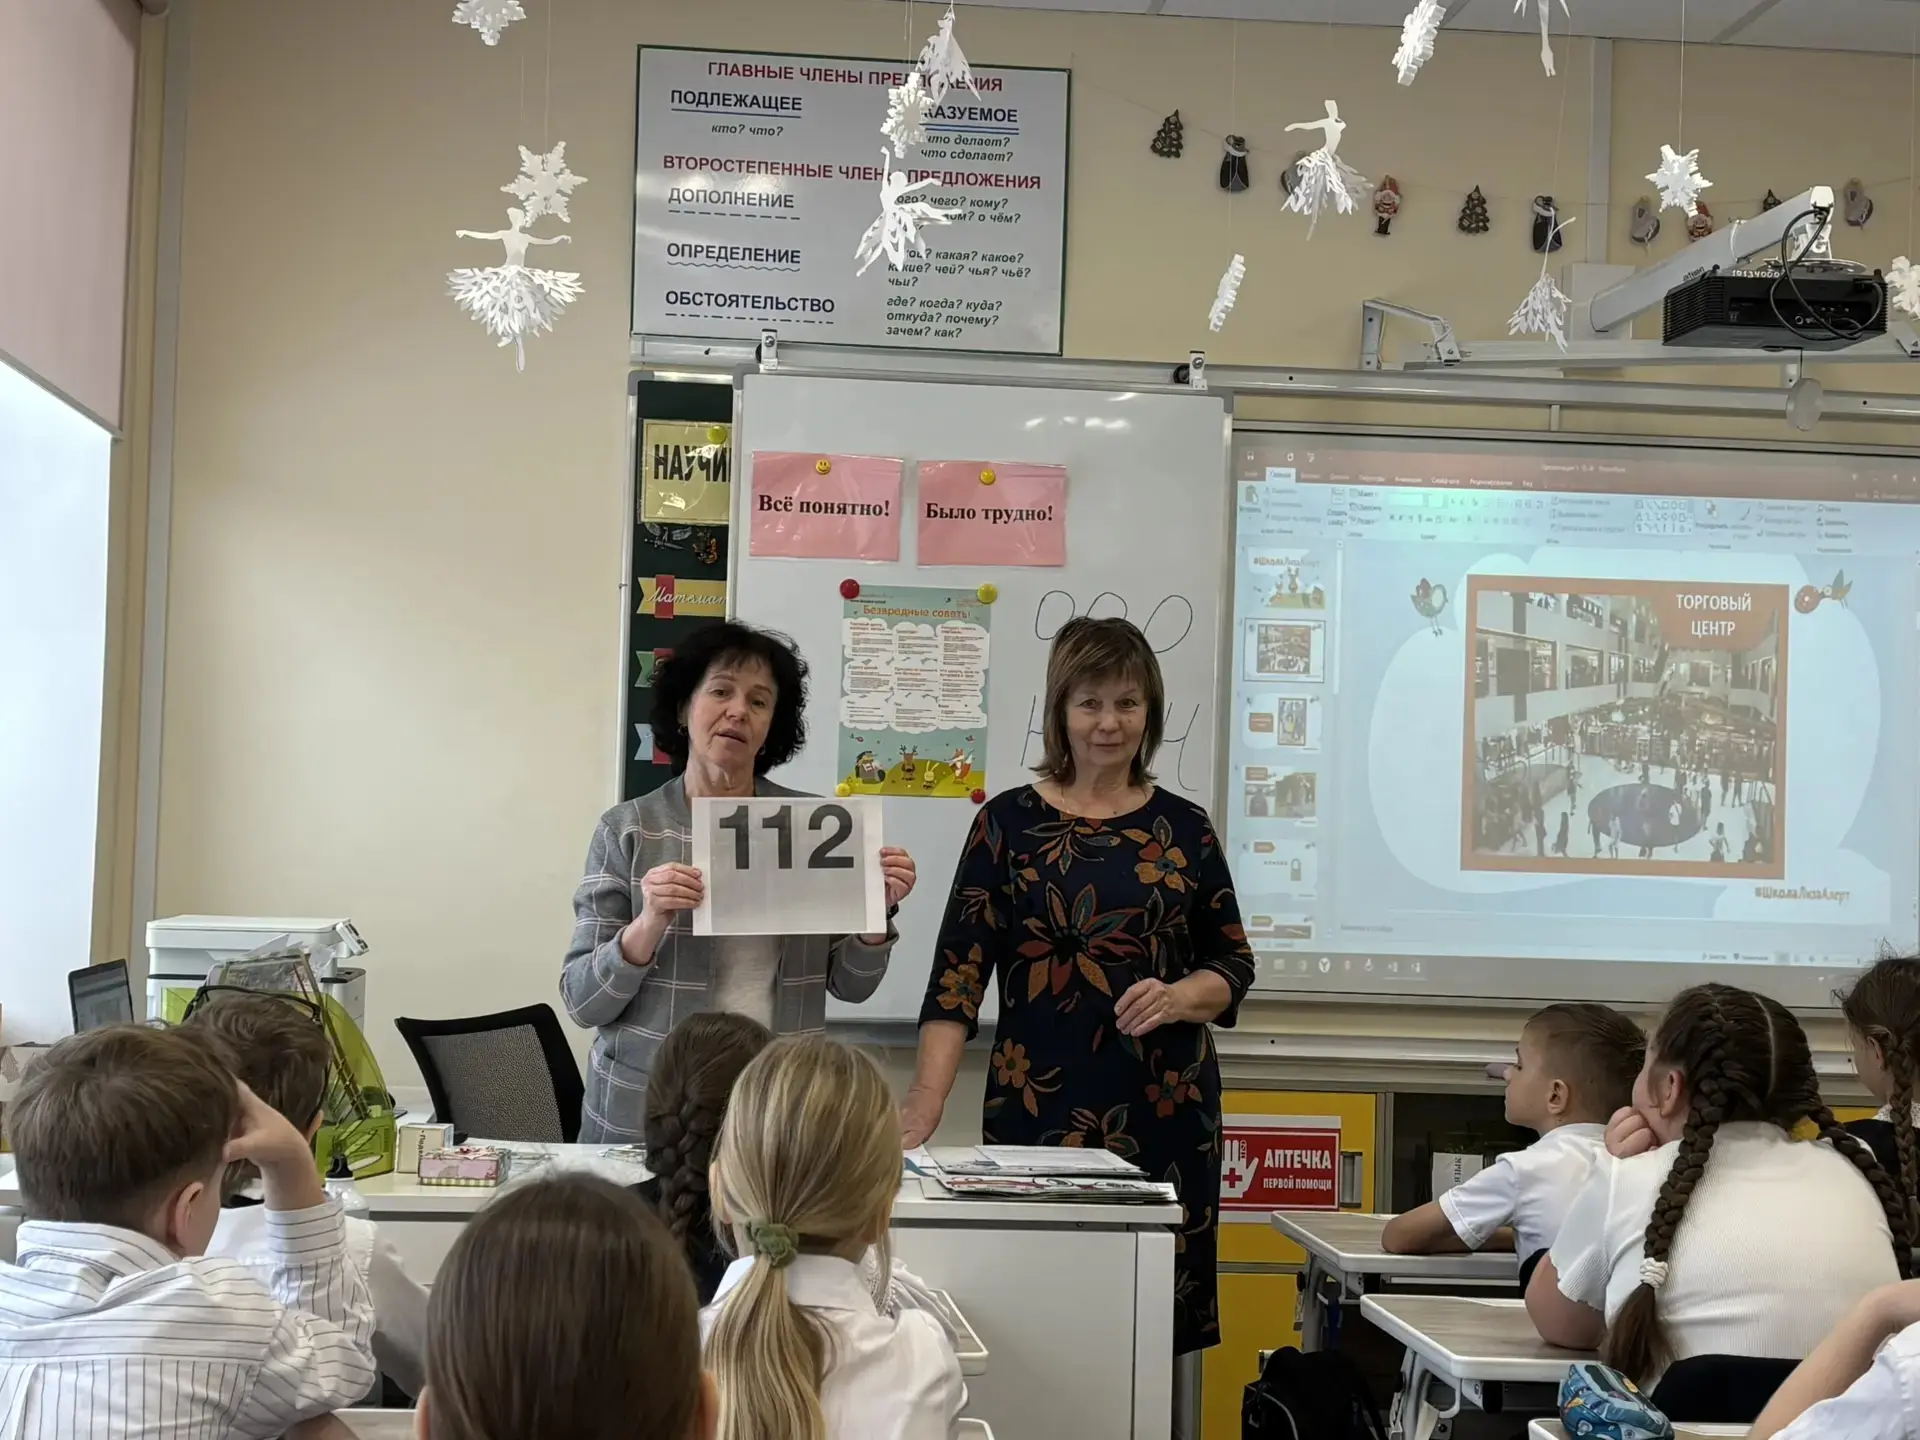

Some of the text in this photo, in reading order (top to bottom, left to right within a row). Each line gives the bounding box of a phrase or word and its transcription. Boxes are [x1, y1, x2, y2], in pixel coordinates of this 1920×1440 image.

[708, 62, 794, 80] ГЛАВНЫЕ
[800, 67, 863, 84] ЧЛЕНЫ
[671, 90, 802, 112] ПОДЛЕЖАЩЕЕ
[712, 124, 784, 136] кто? что?
[954, 134, 1010, 147] делает?
[921, 149, 1013, 161] что сделает?
[663, 155, 833, 178] ВТОРОСТЕПЕННЫЕ
[839, 165, 892, 185] ЧЛЕН
[668, 187, 794, 208] ДОПОЛНЕНИЕ
[896, 194, 1008, 209] ого? чего? кому?
[978, 214, 985, 222] о
[990, 213, 1021, 223] чём?
[667, 242, 801, 264] ОПРЕДЕЛЕНИЕ
[936, 250, 978, 261] какая?
[981, 253, 1024, 263] какое?
[935, 264, 965, 274] чей?
[968, 266, 998, 277] чья?
[1001, 267, 1031, 278] чьё?
[888, 276, 918, 286] чьи?
[665, 290, 835, 313] ОБСТОЯТЕЛЬСТВО
[886, 296, 1002, 312] где? когда? куда?
[886, 311, 999, 327] откуда? почему?
[886, 326, 962, 339] зачем? как?
[758, 494, 890, 517] Всё понятно!
[926, 502, 1053, 524] Было трудно!
[1676, 592, 1752, 611] ТОРГОВЫЙ
[863, 604, 929, 617] Безвредные
[1691, 620, 1736, 639] ЦЕНТР
[719, 804, 855, 869] 112
[1264, 1148, 1332, 1169] АПТЕЧКА
[1263, 1174, 1332, 1191] ПЕРВОЙ ПОМОЩИ
